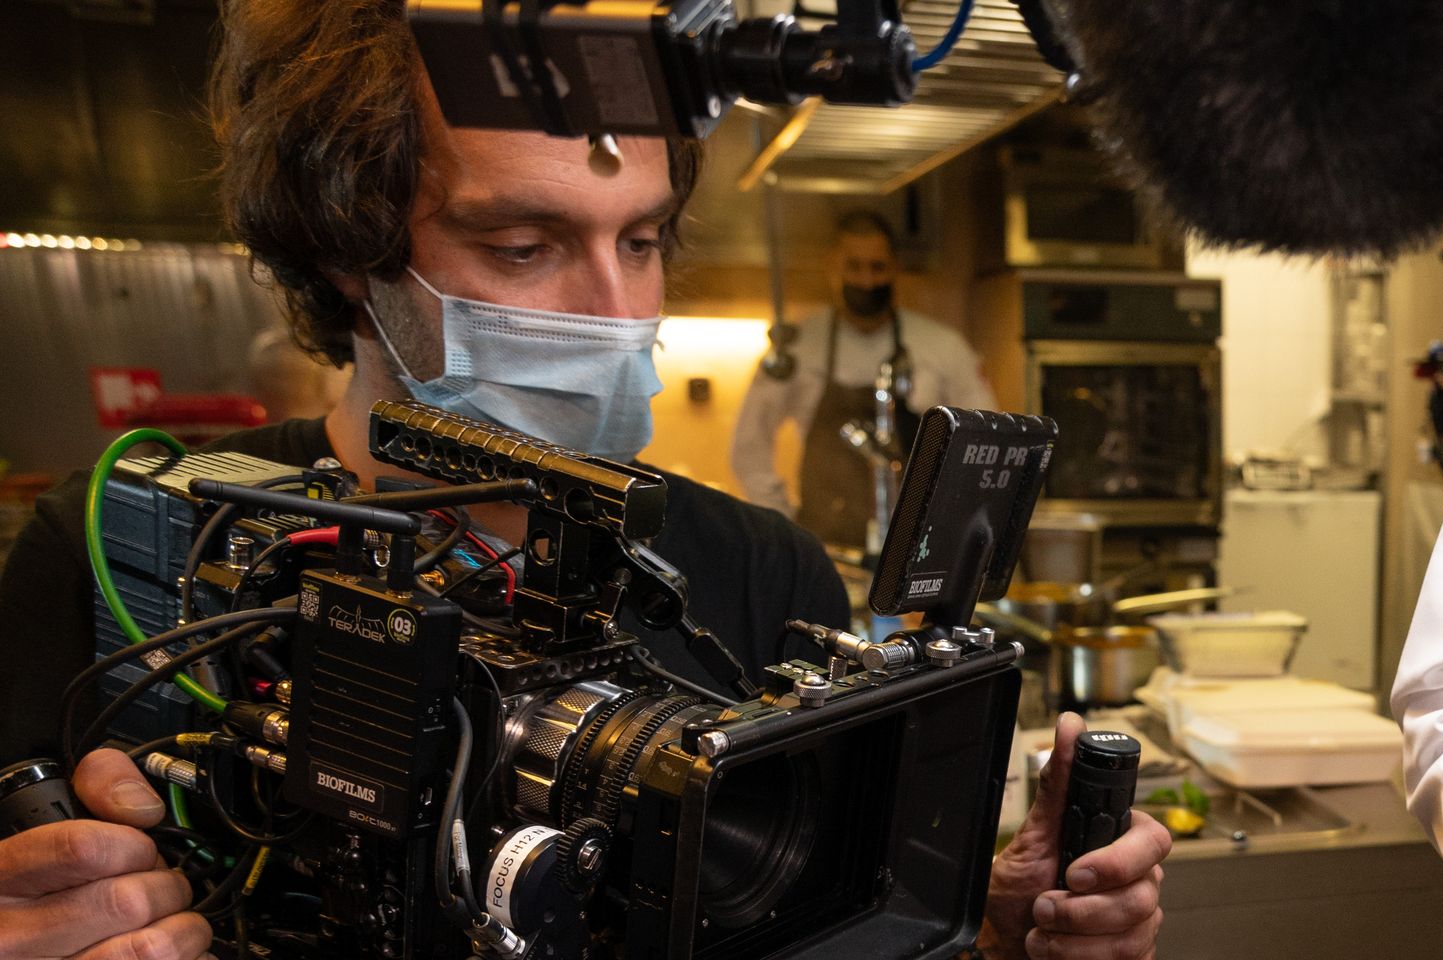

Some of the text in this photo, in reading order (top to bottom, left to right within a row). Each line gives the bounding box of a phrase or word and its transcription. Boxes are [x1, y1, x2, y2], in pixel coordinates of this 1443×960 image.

[962, 444, 1000, 465] RED
[979, 469, 1011, 489] 5.0
[908, 578, 944, 594] BIOFILMS
[328, 616, 386, 644] TERADEK
[394, 616, 412, 635] 03
[316, 771, 376, 804] BIOFILMS
[492, 857, 515, 908] FOCUS
[511, 834, 535, 855] H12
